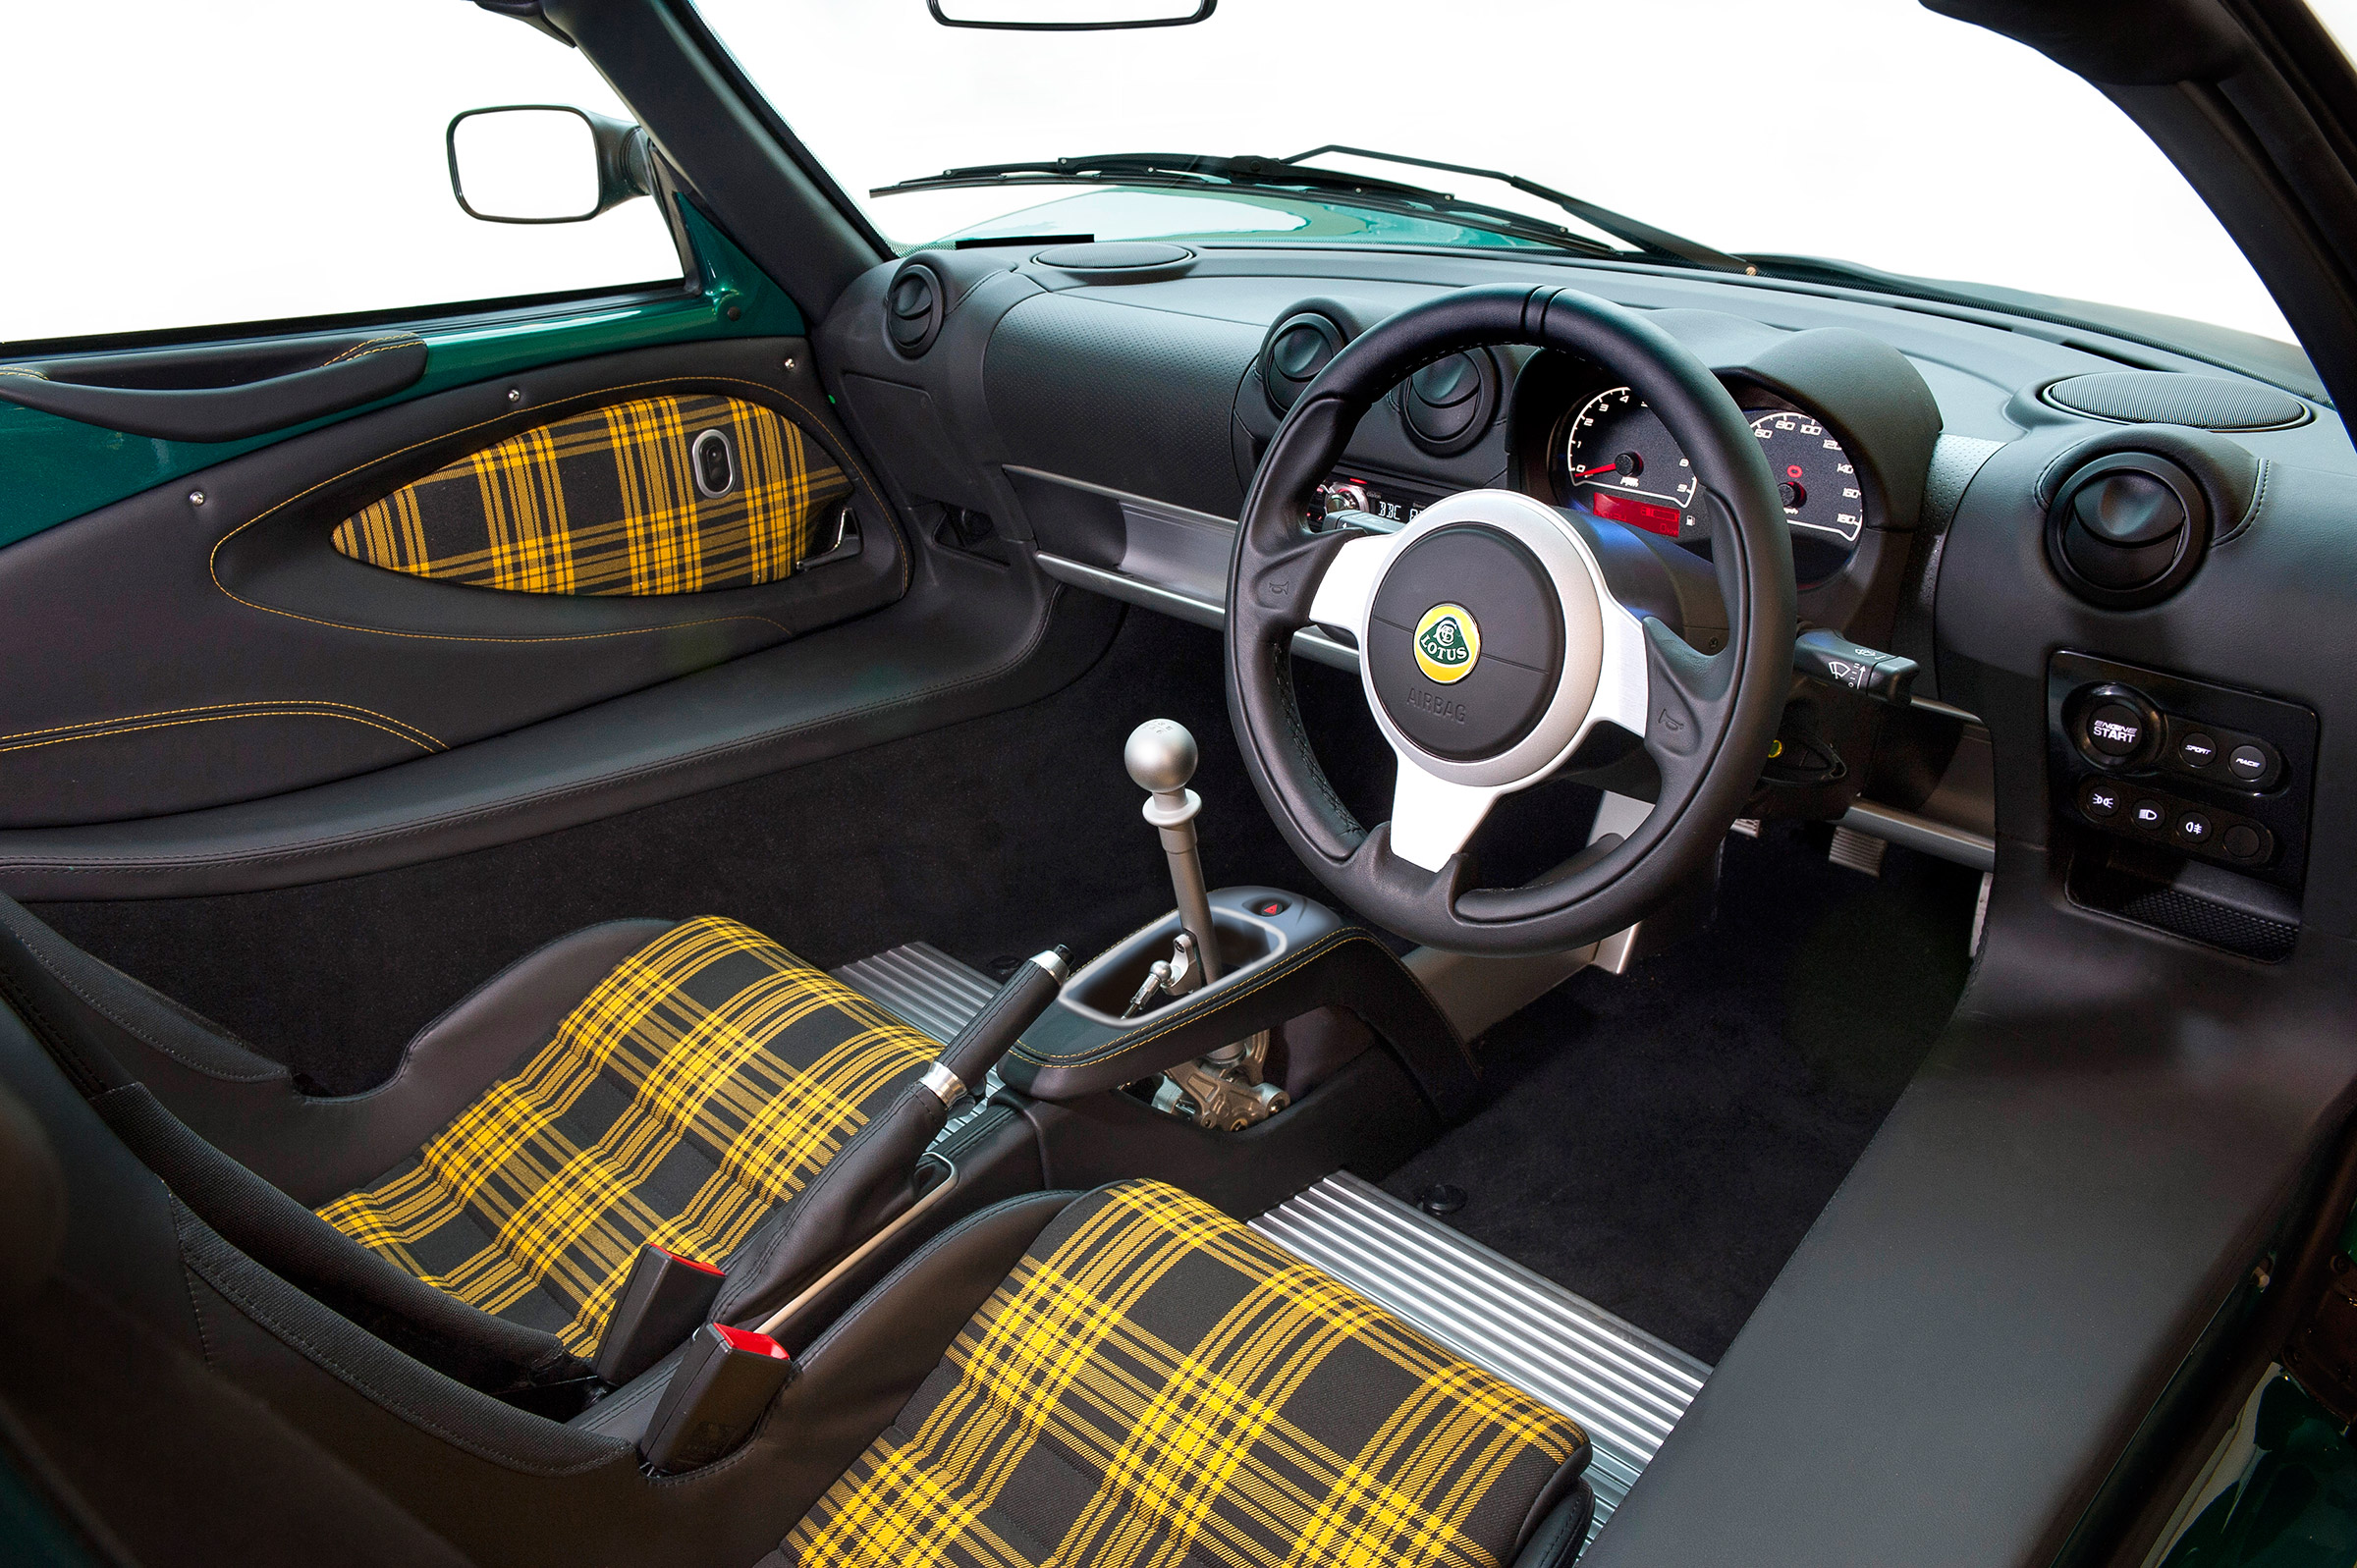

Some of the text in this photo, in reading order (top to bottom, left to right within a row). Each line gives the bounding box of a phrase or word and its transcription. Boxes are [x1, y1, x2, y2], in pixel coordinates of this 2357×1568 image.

[1619, 395, 1629, 404] 4
[1598, 404, 1609, 412] 3
[1583, 418, 1594, 427] 2
[1775, 420, 1796, 431] 80
[1800, 423, 1822, 436] 100
[1379, 501, 1402, 520] BBC
[1420, 633, 1467, 662] LOTUS
[1405, 687, 1466, 725] AIRBAG
[2094, 720, 2138, 734] ENGINE
[2093, 726, 2136, 743] START
[2185, 744, 2212, 755] SPORT
[2235, 757, 2261, 768] RACE
